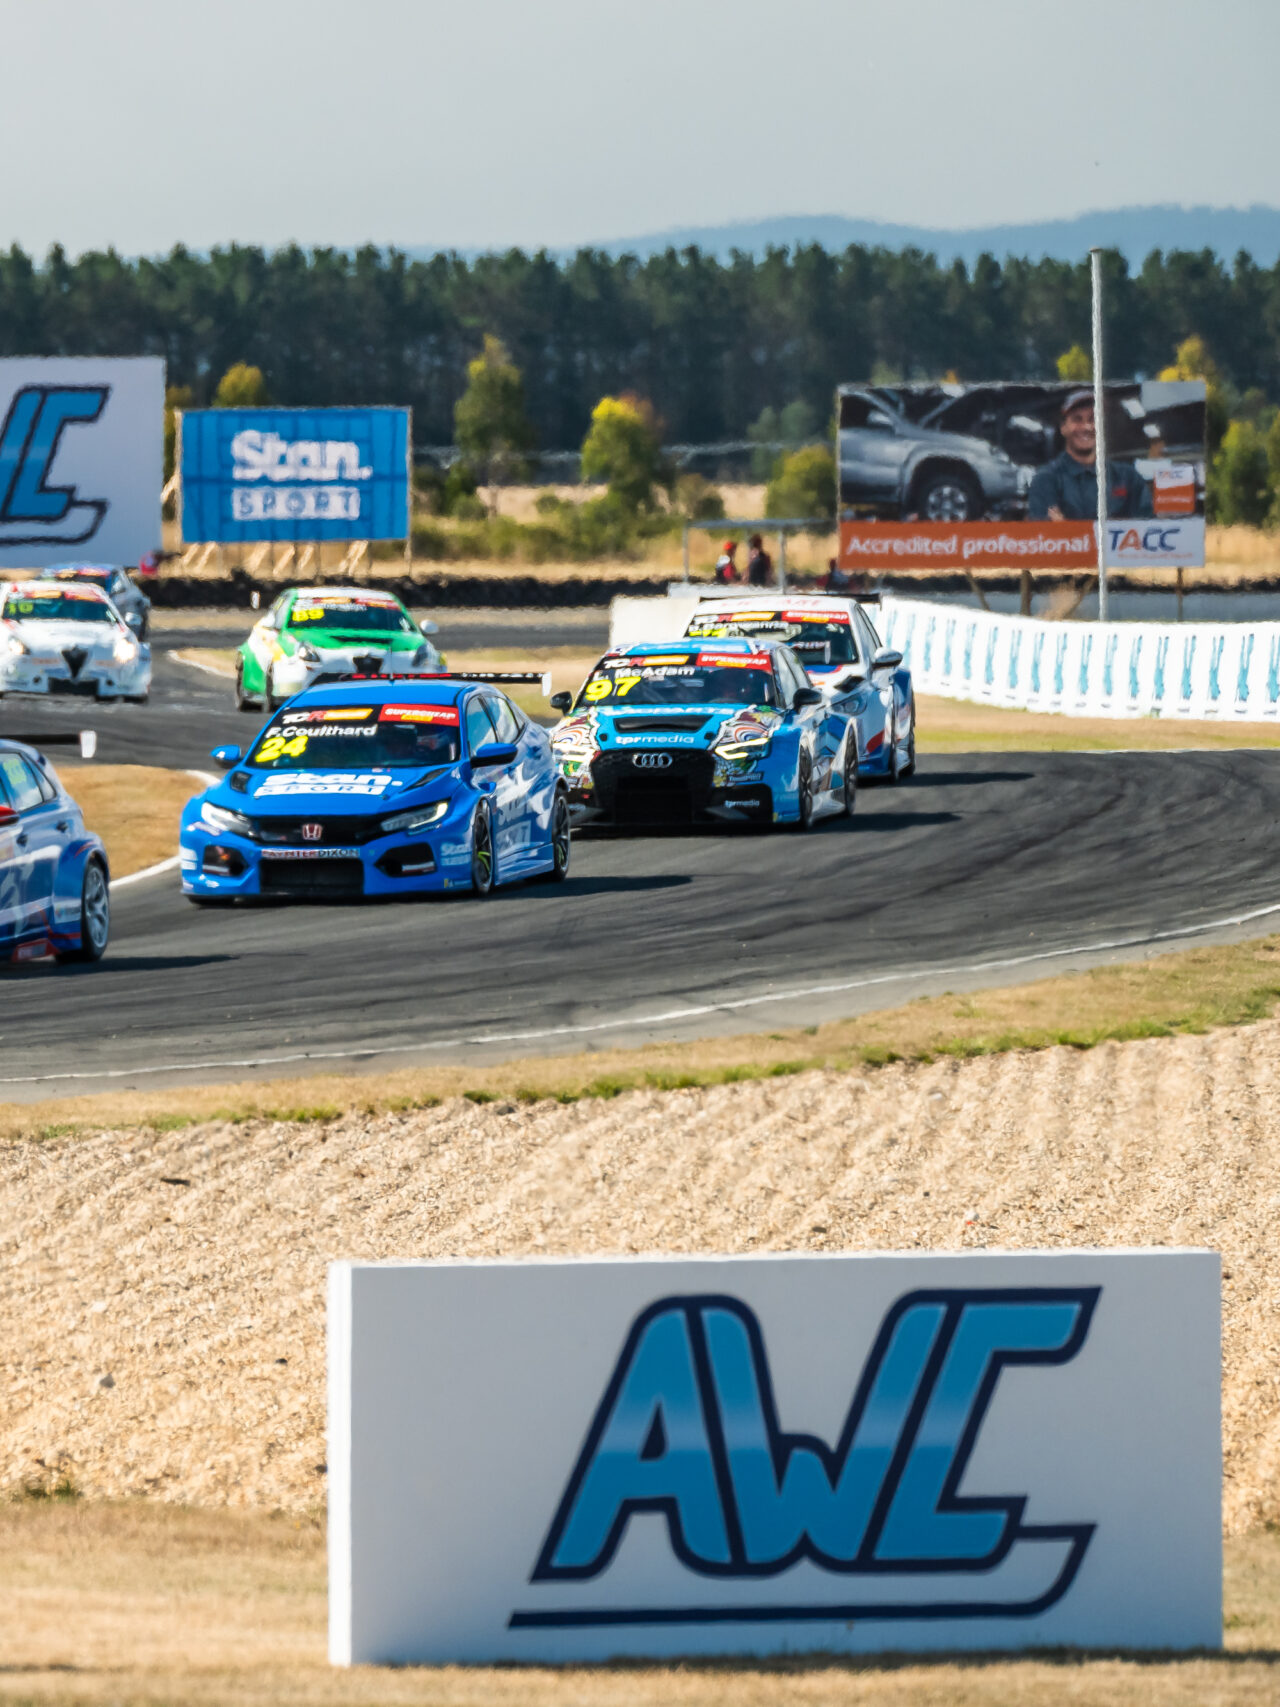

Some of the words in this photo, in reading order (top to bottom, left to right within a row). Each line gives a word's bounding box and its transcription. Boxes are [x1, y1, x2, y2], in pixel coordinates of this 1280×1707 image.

[232, 486, 360, 519] SPORT
[847, 534, 958, 556] Accredited
[962, 534, 1090, 559] professional
[1108, 527, 1181, 553] TACC
[614, 666, 696, 680] McAdam
[585, 676, 642, 702] 97
[254, 736, 308, 763] 24
[517, 1286, 1104, 1610] AWC
